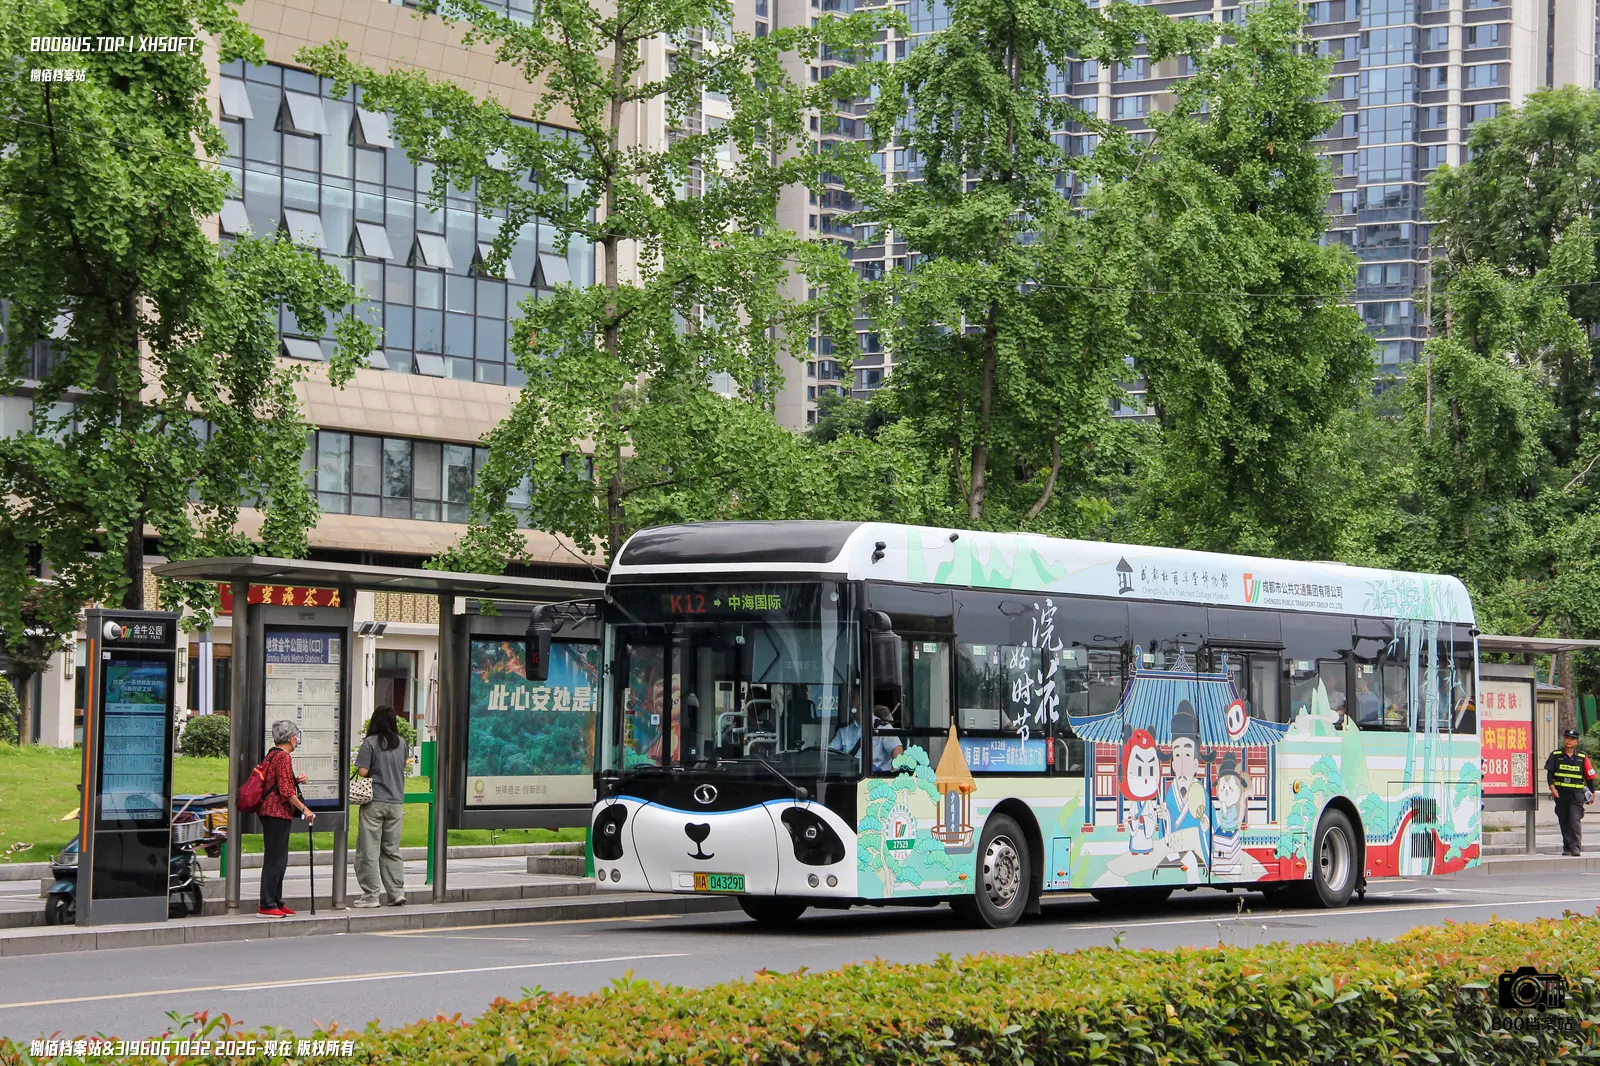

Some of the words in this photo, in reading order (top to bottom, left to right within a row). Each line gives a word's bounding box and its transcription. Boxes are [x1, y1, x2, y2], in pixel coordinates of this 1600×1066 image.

[1263, 580, 1344, 598] 成都市公共交通集团有限公司
[1213, 592, 1230, 600] Museum
[671, 594, 706, 613] K12
[728, 594, 782, 611] 中海国际
[1264, 598, 1281, 606] CHENGDU
[1282, 599, 1295, 607] PUBLIC
[1295, 600, 1316, 608] TRANSPORT
[1316, 601, 1329, 609] GROUP
[133, 624, 163, 636] 金牛公园
[280, 654, 290, 663] Park
[291, 655, 305, 664] Metro
[1010, 641, 1035, 752] 好时节
